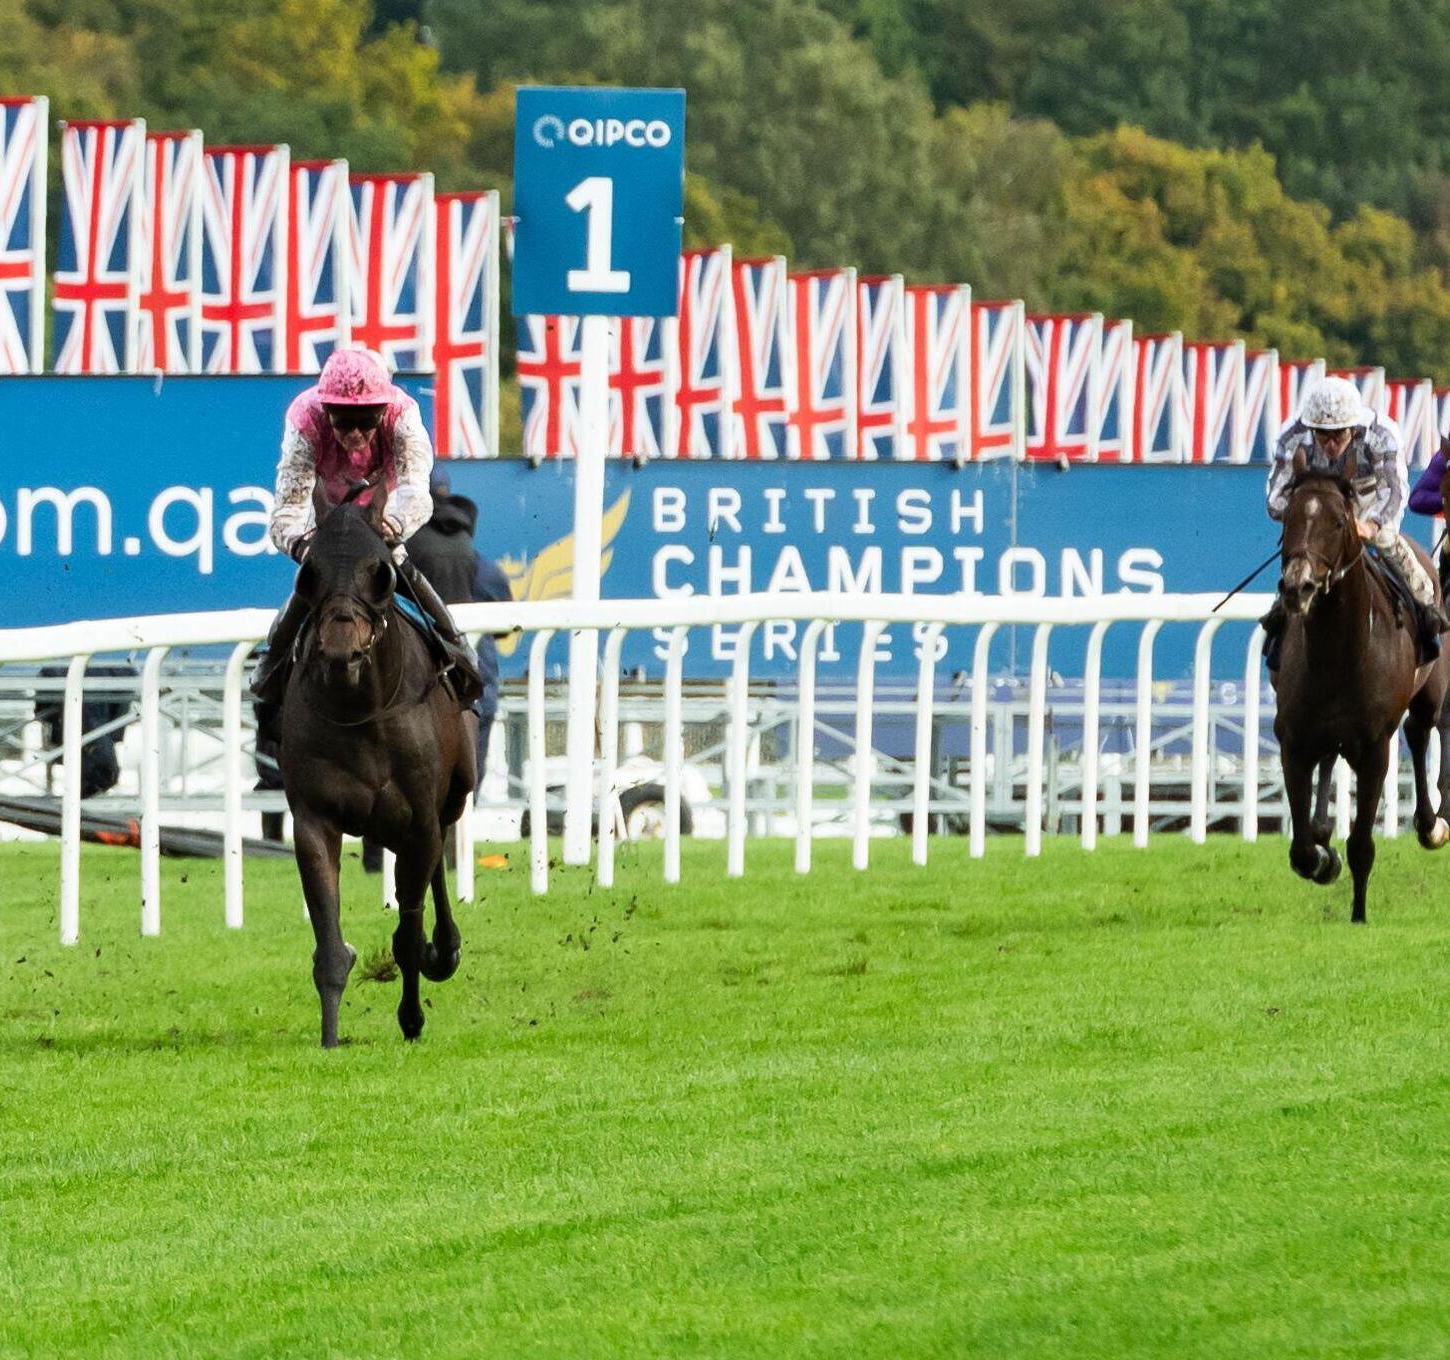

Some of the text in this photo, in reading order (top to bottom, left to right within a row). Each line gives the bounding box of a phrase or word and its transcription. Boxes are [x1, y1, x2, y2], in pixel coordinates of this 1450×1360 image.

[567, 117, 672, 148] QIPCO
[565, 176, 631, 293] 1
[652, 486, 985, 535] BRITISH
[652, 544, 1165, 599] CHAMPIONS
